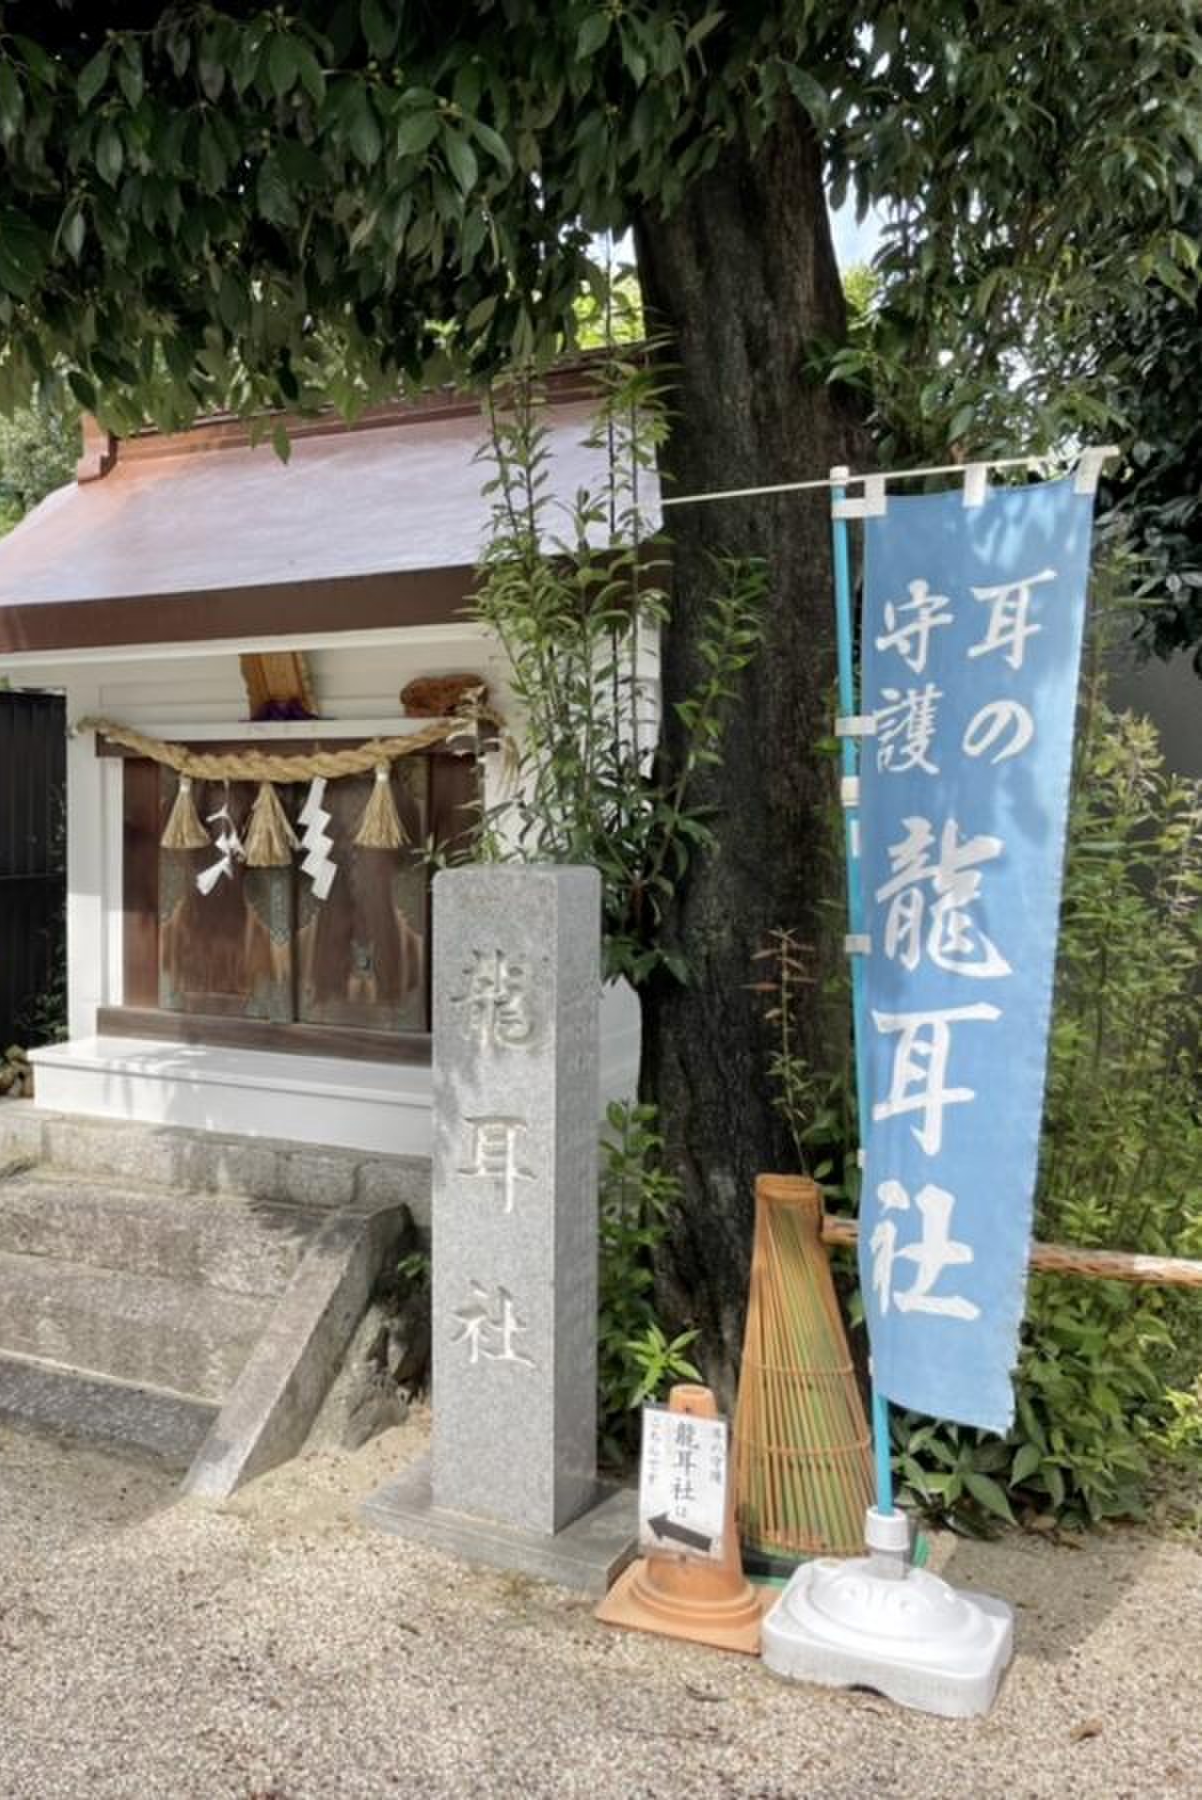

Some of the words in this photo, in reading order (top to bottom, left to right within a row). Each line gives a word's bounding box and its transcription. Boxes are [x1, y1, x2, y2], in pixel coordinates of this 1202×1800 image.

[872, 578, 954, 775] 守護
[963, 568, 1058, 764] 耳の
[871, 815, 1012, 1322] 龍耳社
